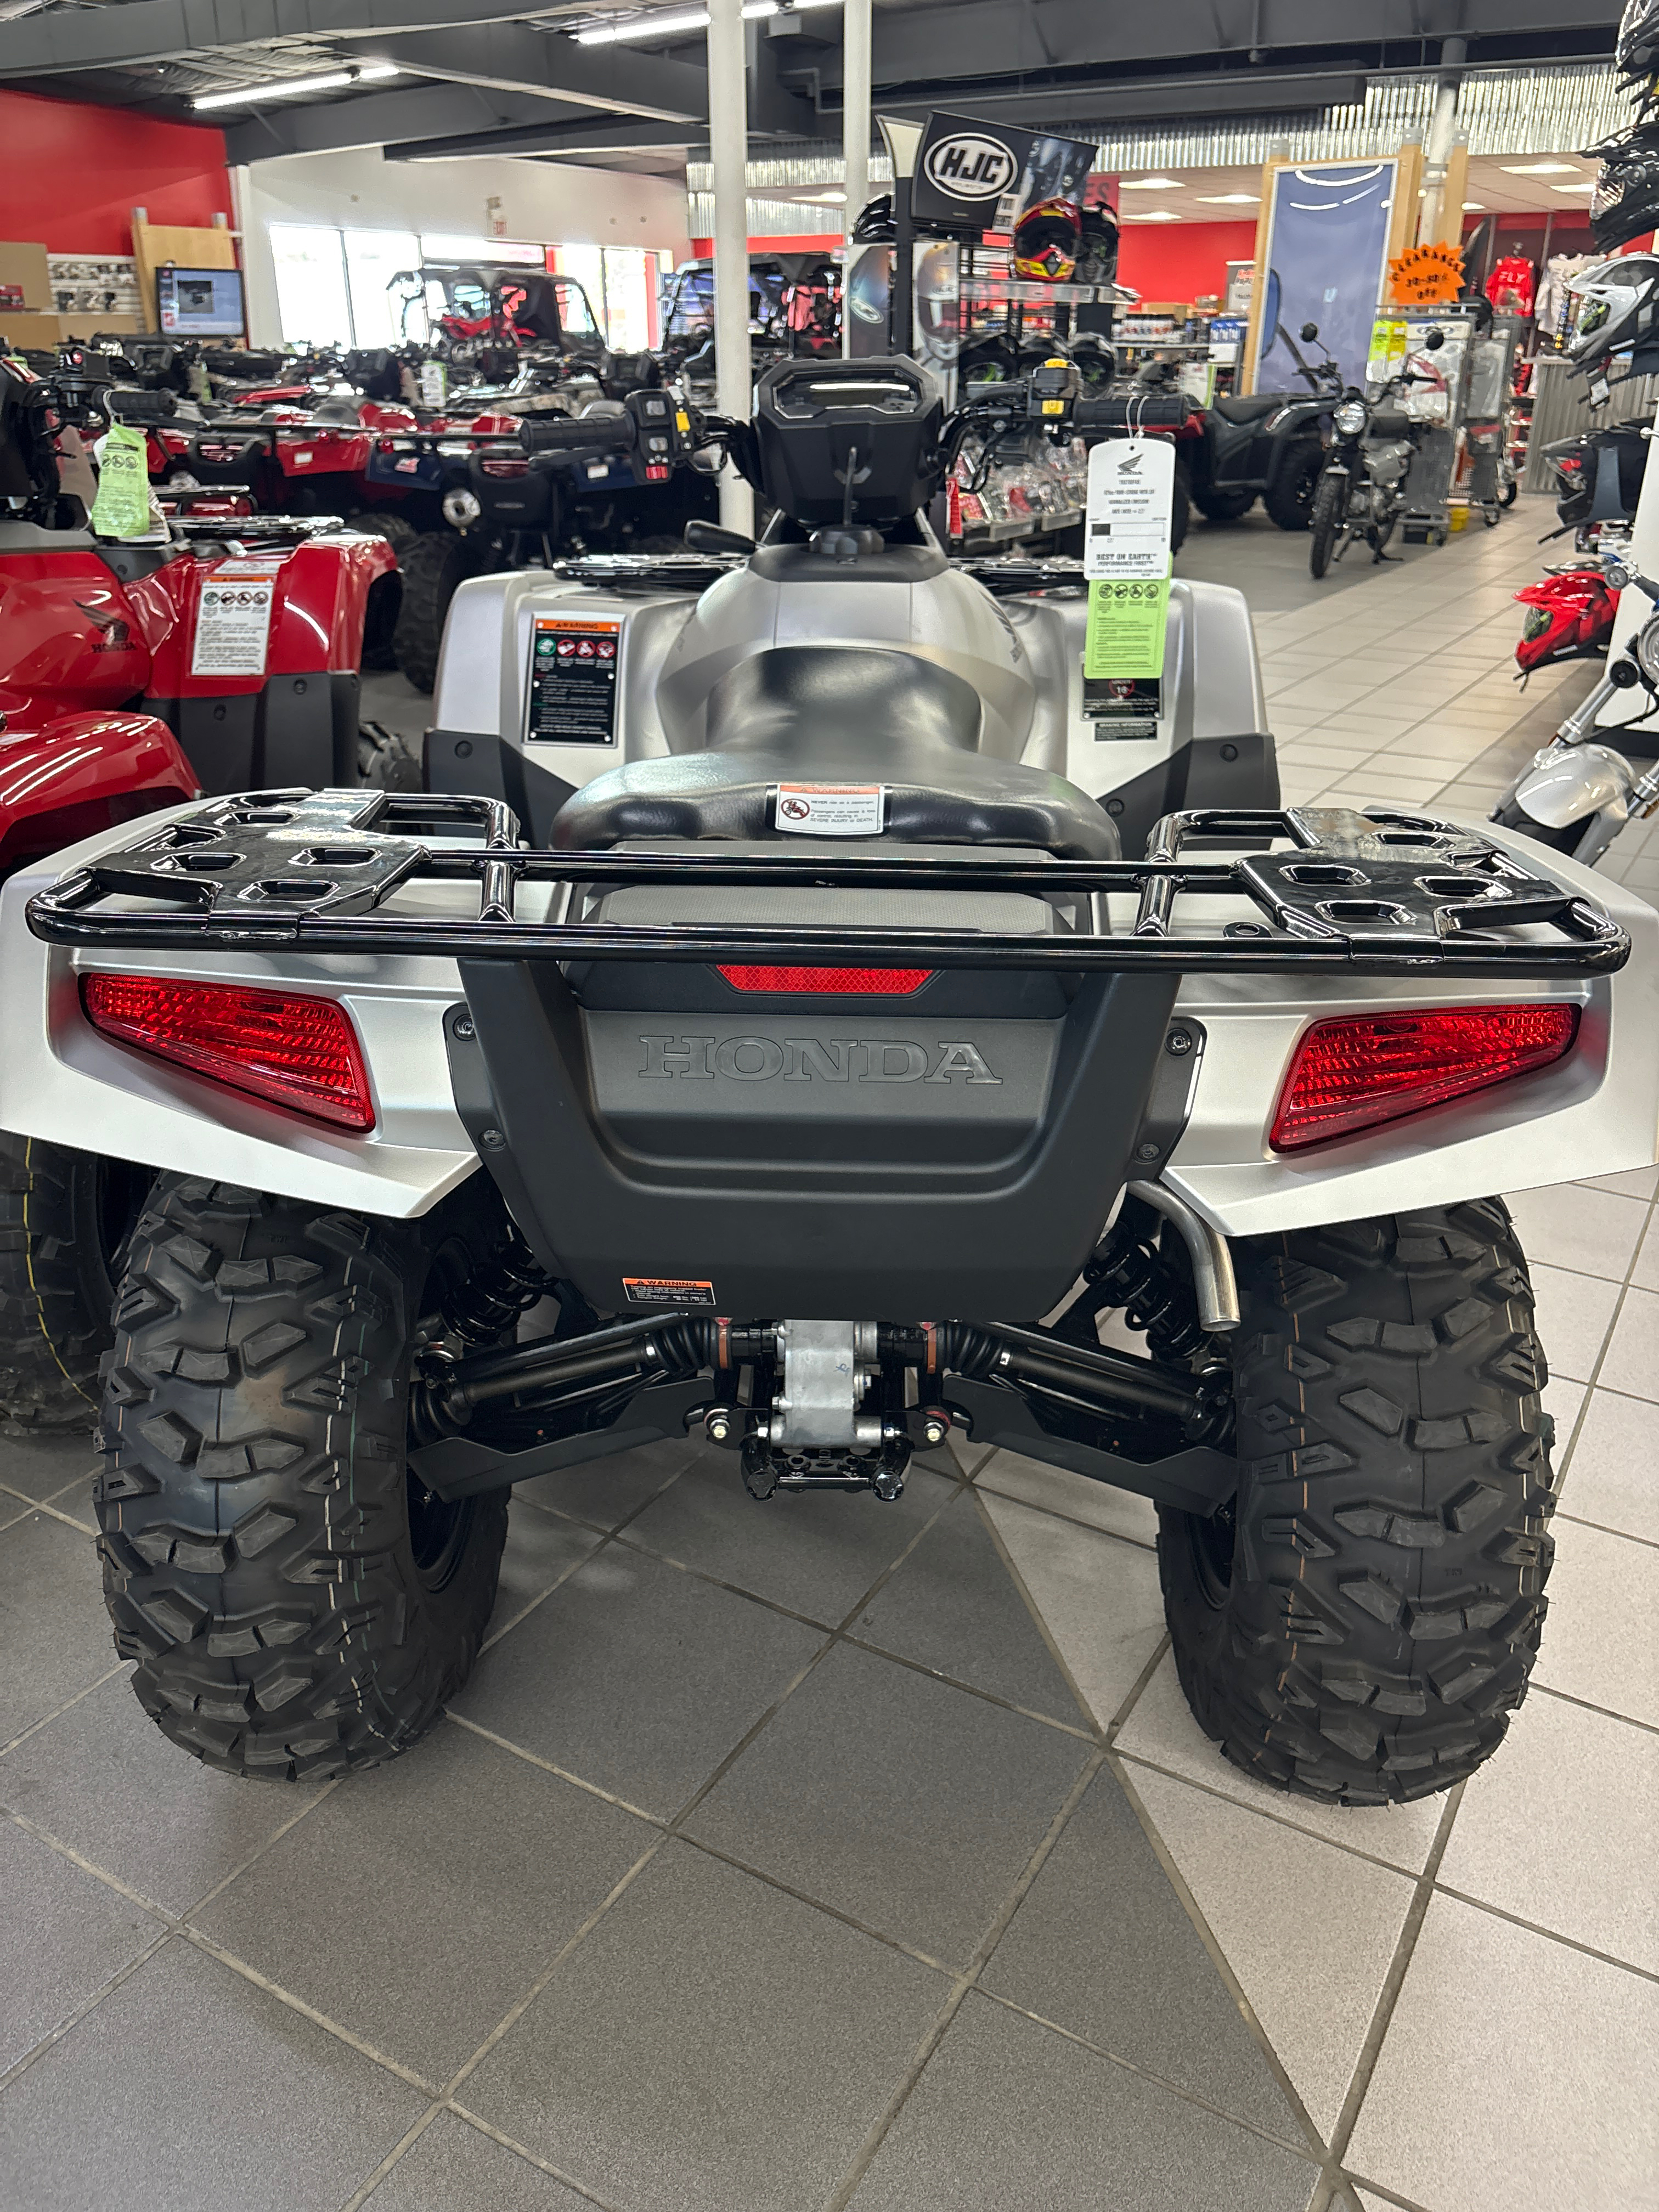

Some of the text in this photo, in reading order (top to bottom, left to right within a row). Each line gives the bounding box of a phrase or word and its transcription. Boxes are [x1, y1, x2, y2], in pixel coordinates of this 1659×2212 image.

[940, 146, 1005, 184] HJC
[1498, 270, 1527, 284] FLY
[638, 1035, 1003, 1085] HONDA
